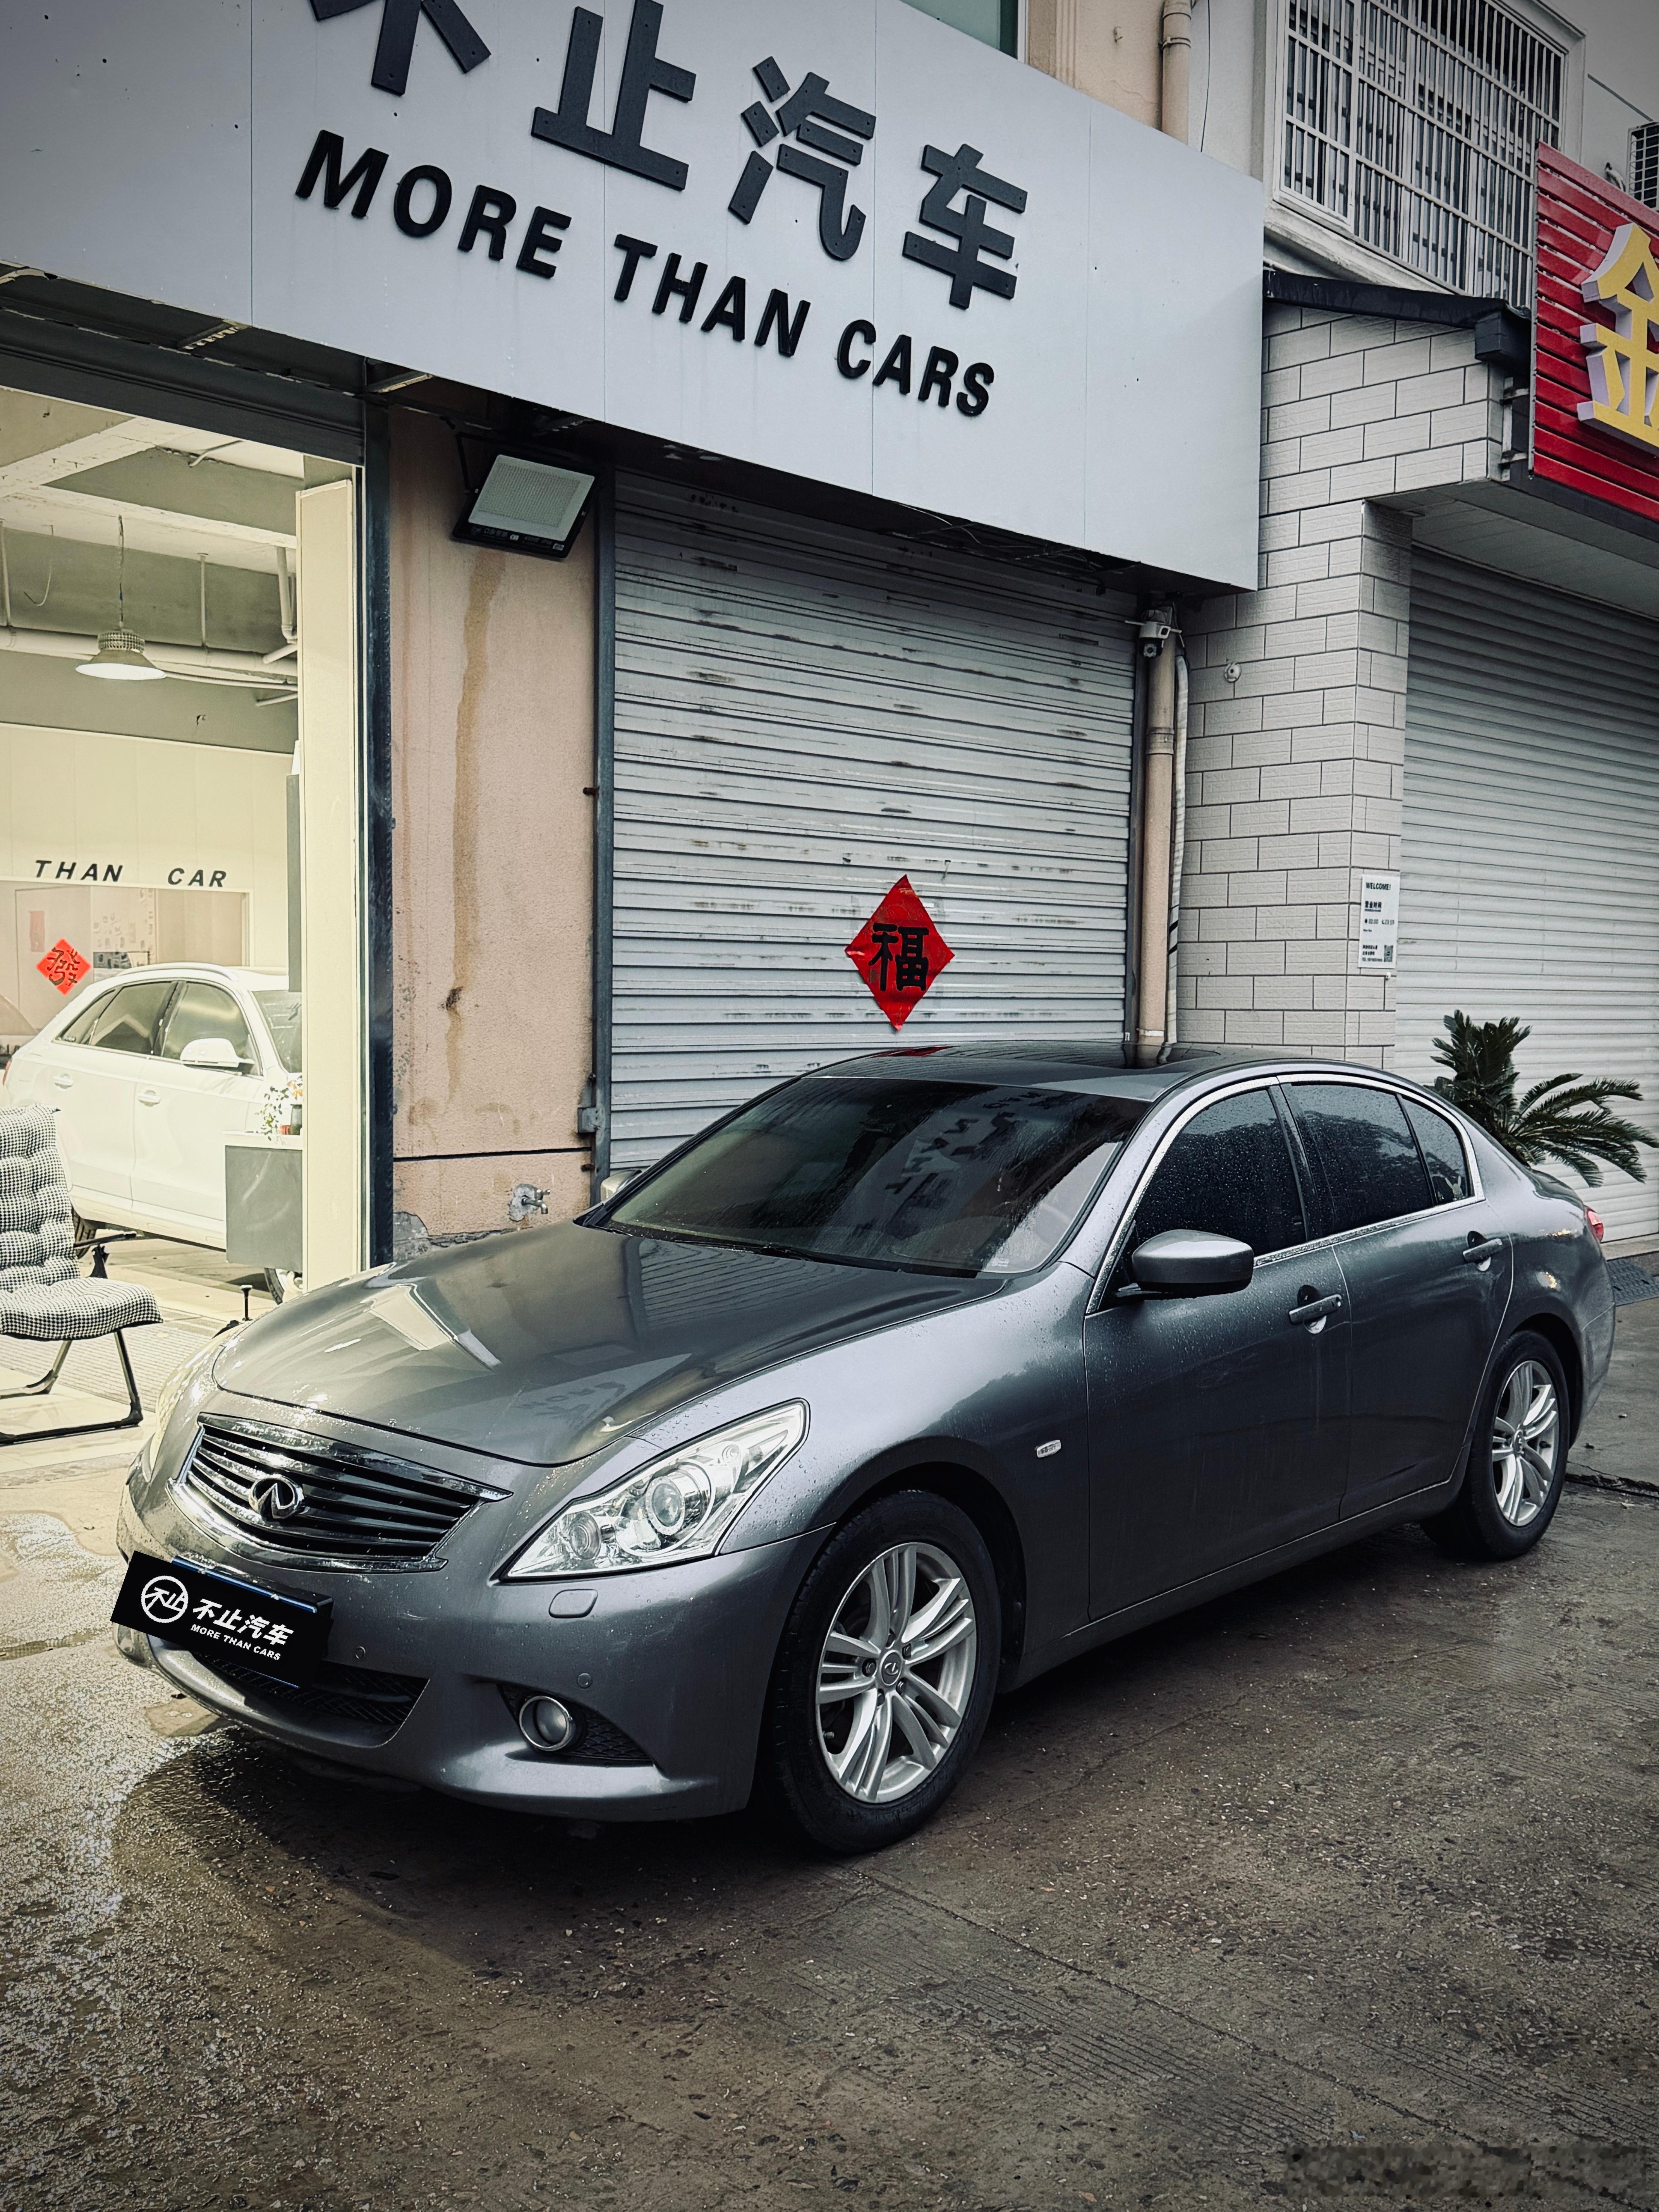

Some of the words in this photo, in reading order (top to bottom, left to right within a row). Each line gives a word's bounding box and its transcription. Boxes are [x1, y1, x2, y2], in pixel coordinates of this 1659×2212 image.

[295, 130, 572, 279] MORE
[614, 234, 811, 357] THAN
[836, 319, 994, 417] CARS
[36, 860, 123, 882] THAN
[168, 868, 226, 887] CAR
[868, 922, 930, 992] 福
